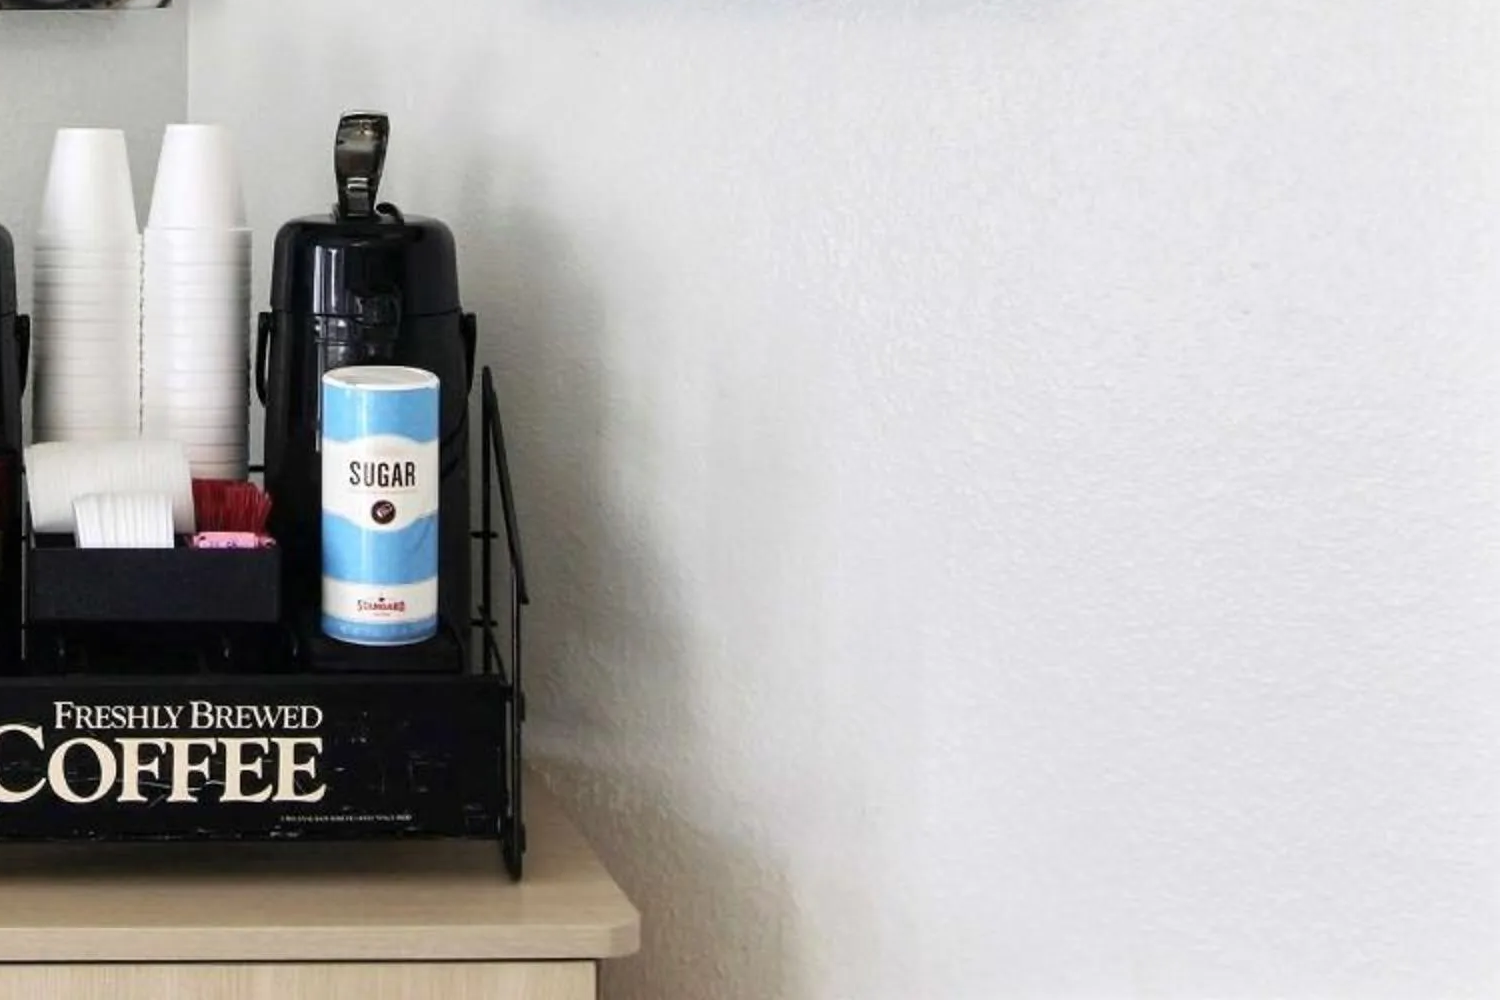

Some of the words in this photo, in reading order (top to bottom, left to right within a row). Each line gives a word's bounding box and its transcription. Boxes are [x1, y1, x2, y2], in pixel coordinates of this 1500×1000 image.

[349, 461, 416, 487] SUGAR
[53, 701, 184, 730] FRESHLY
[190, 700, 323, 730] BREWED
